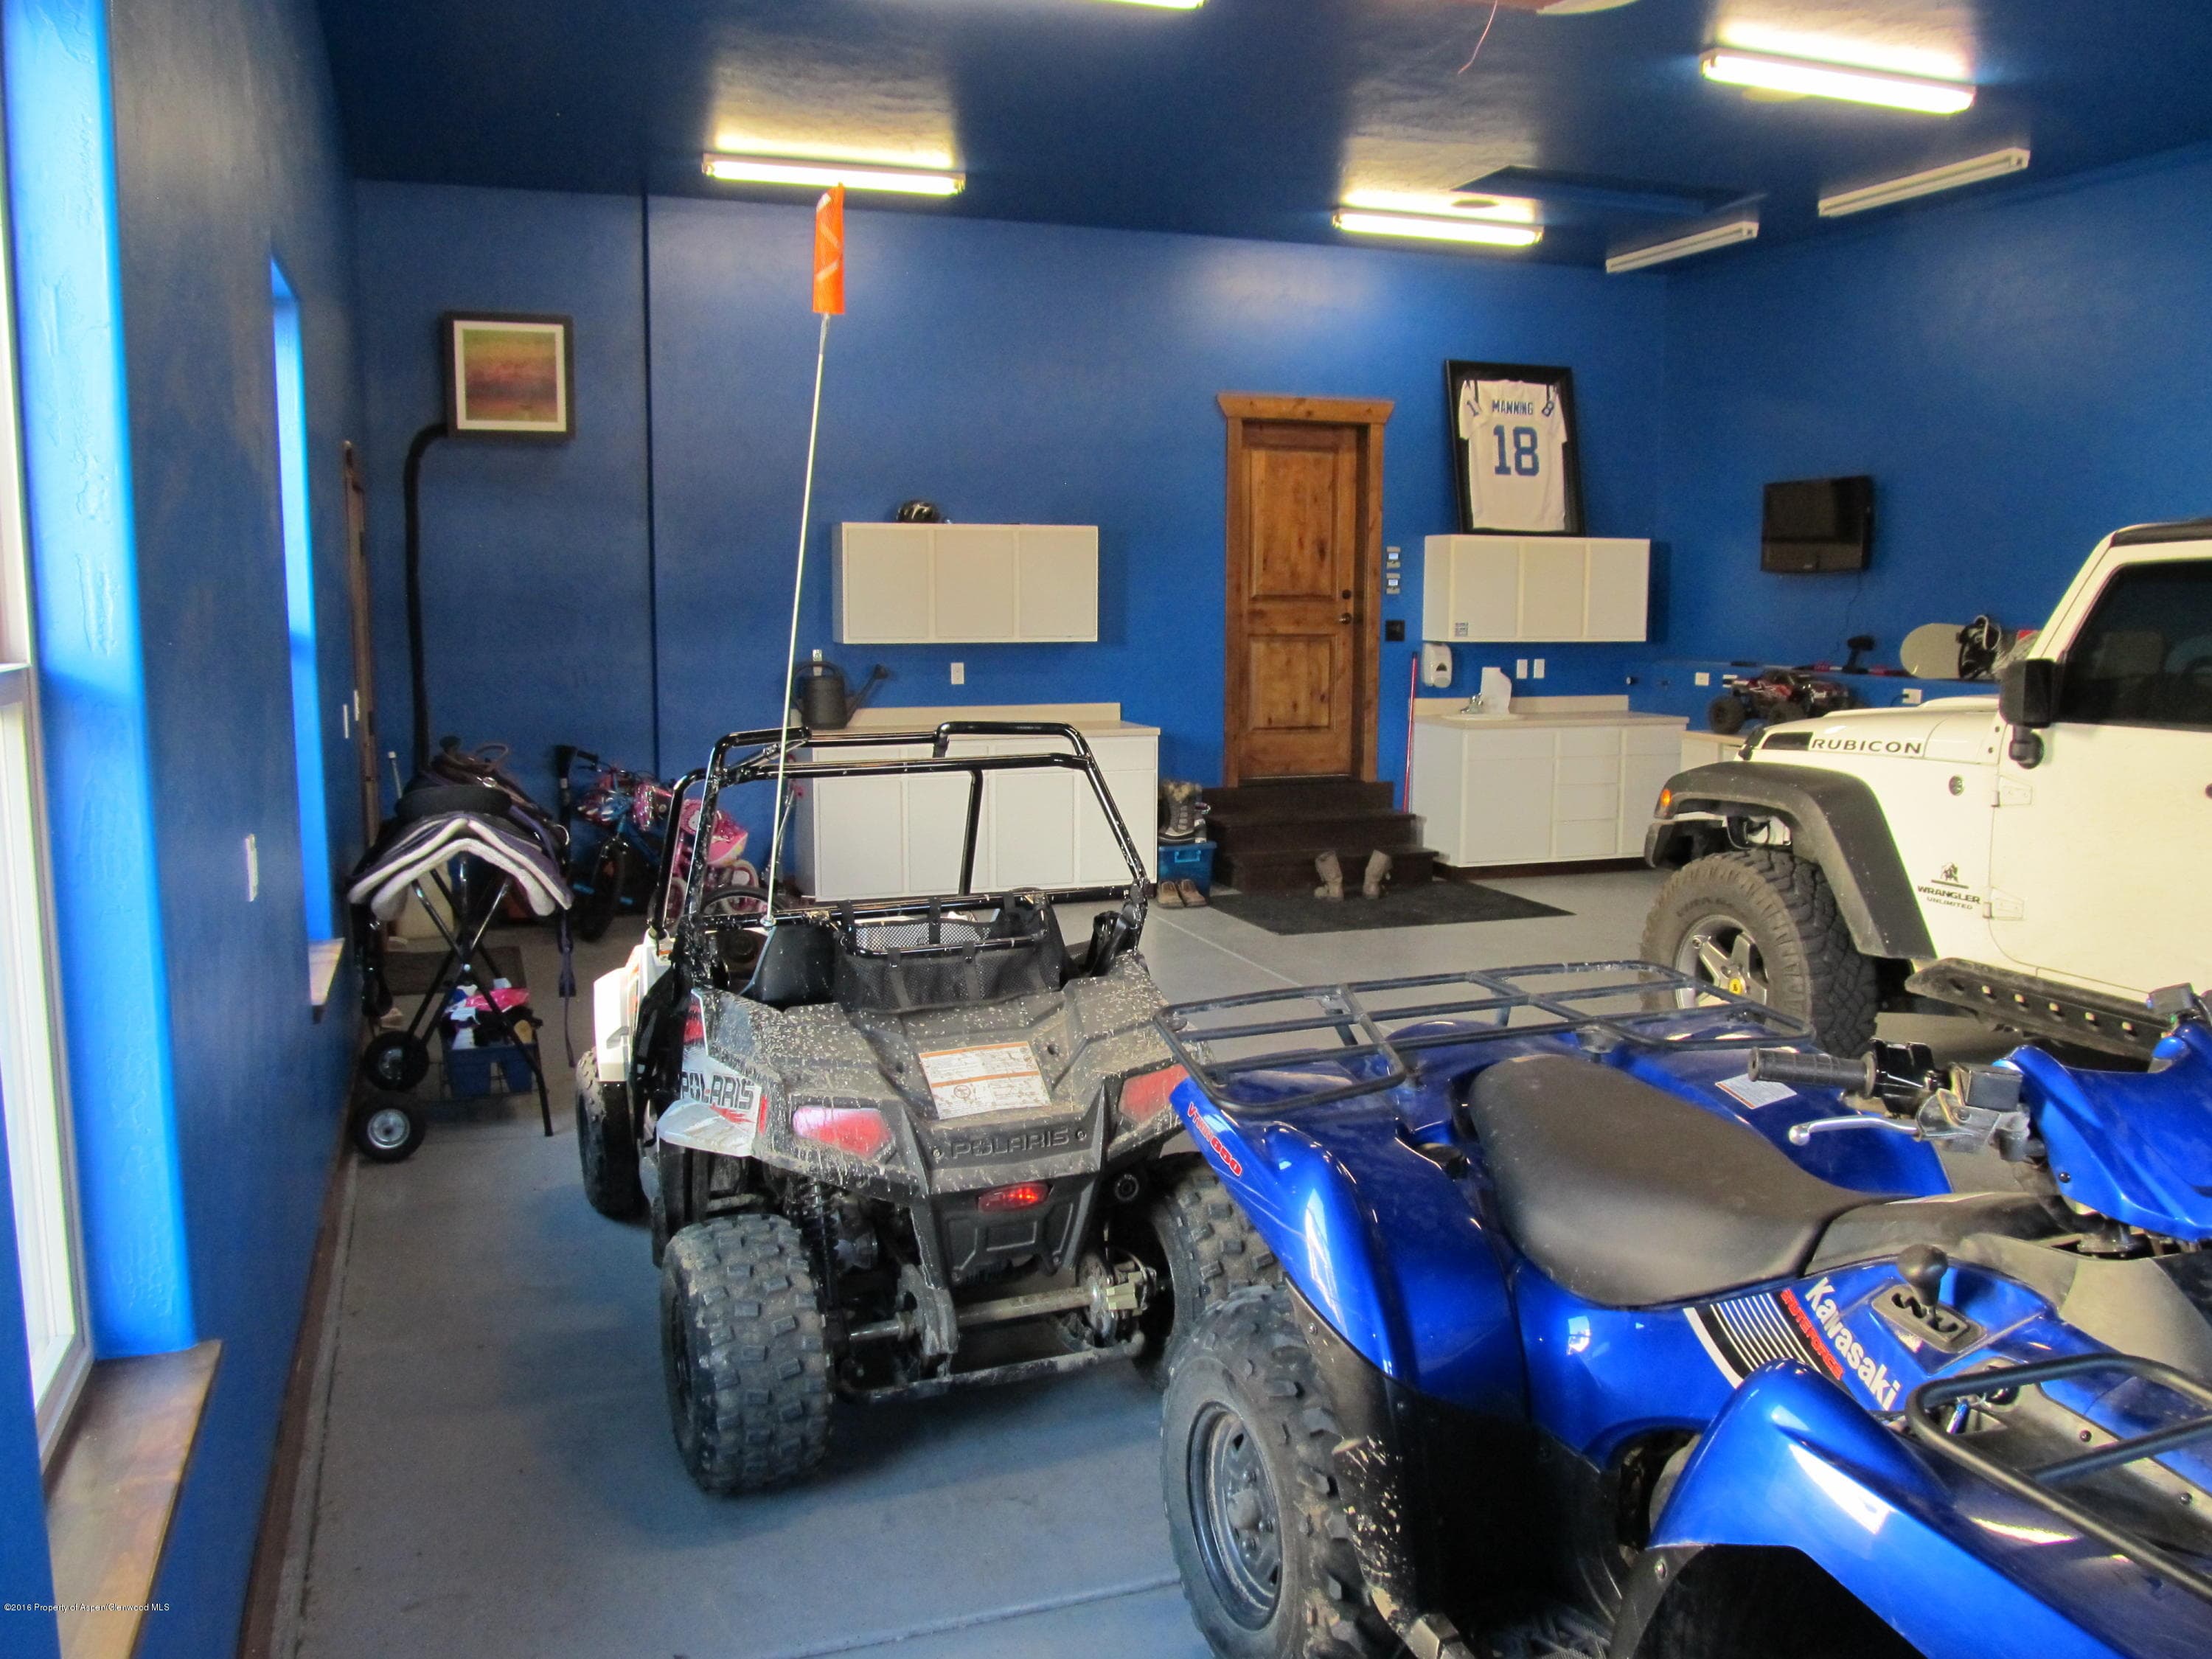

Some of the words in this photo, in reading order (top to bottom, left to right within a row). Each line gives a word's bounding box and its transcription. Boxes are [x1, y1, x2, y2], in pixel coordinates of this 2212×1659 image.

[1492, 400, 1534, 416] MANNING
[1493, 424, 1540, 476] 18
[1811, 738, 1921, 754] RUBICON
[1917, 886, 1980, 905] WRANGLER
[1927, 896, 1973, 910] UNLIMITED
[681, 1071, 754, 1110] POLARIS
[950, 1127, 1069, 1159] POLARIS
[1805, 1277, 1902, 1411] Kawasaki
